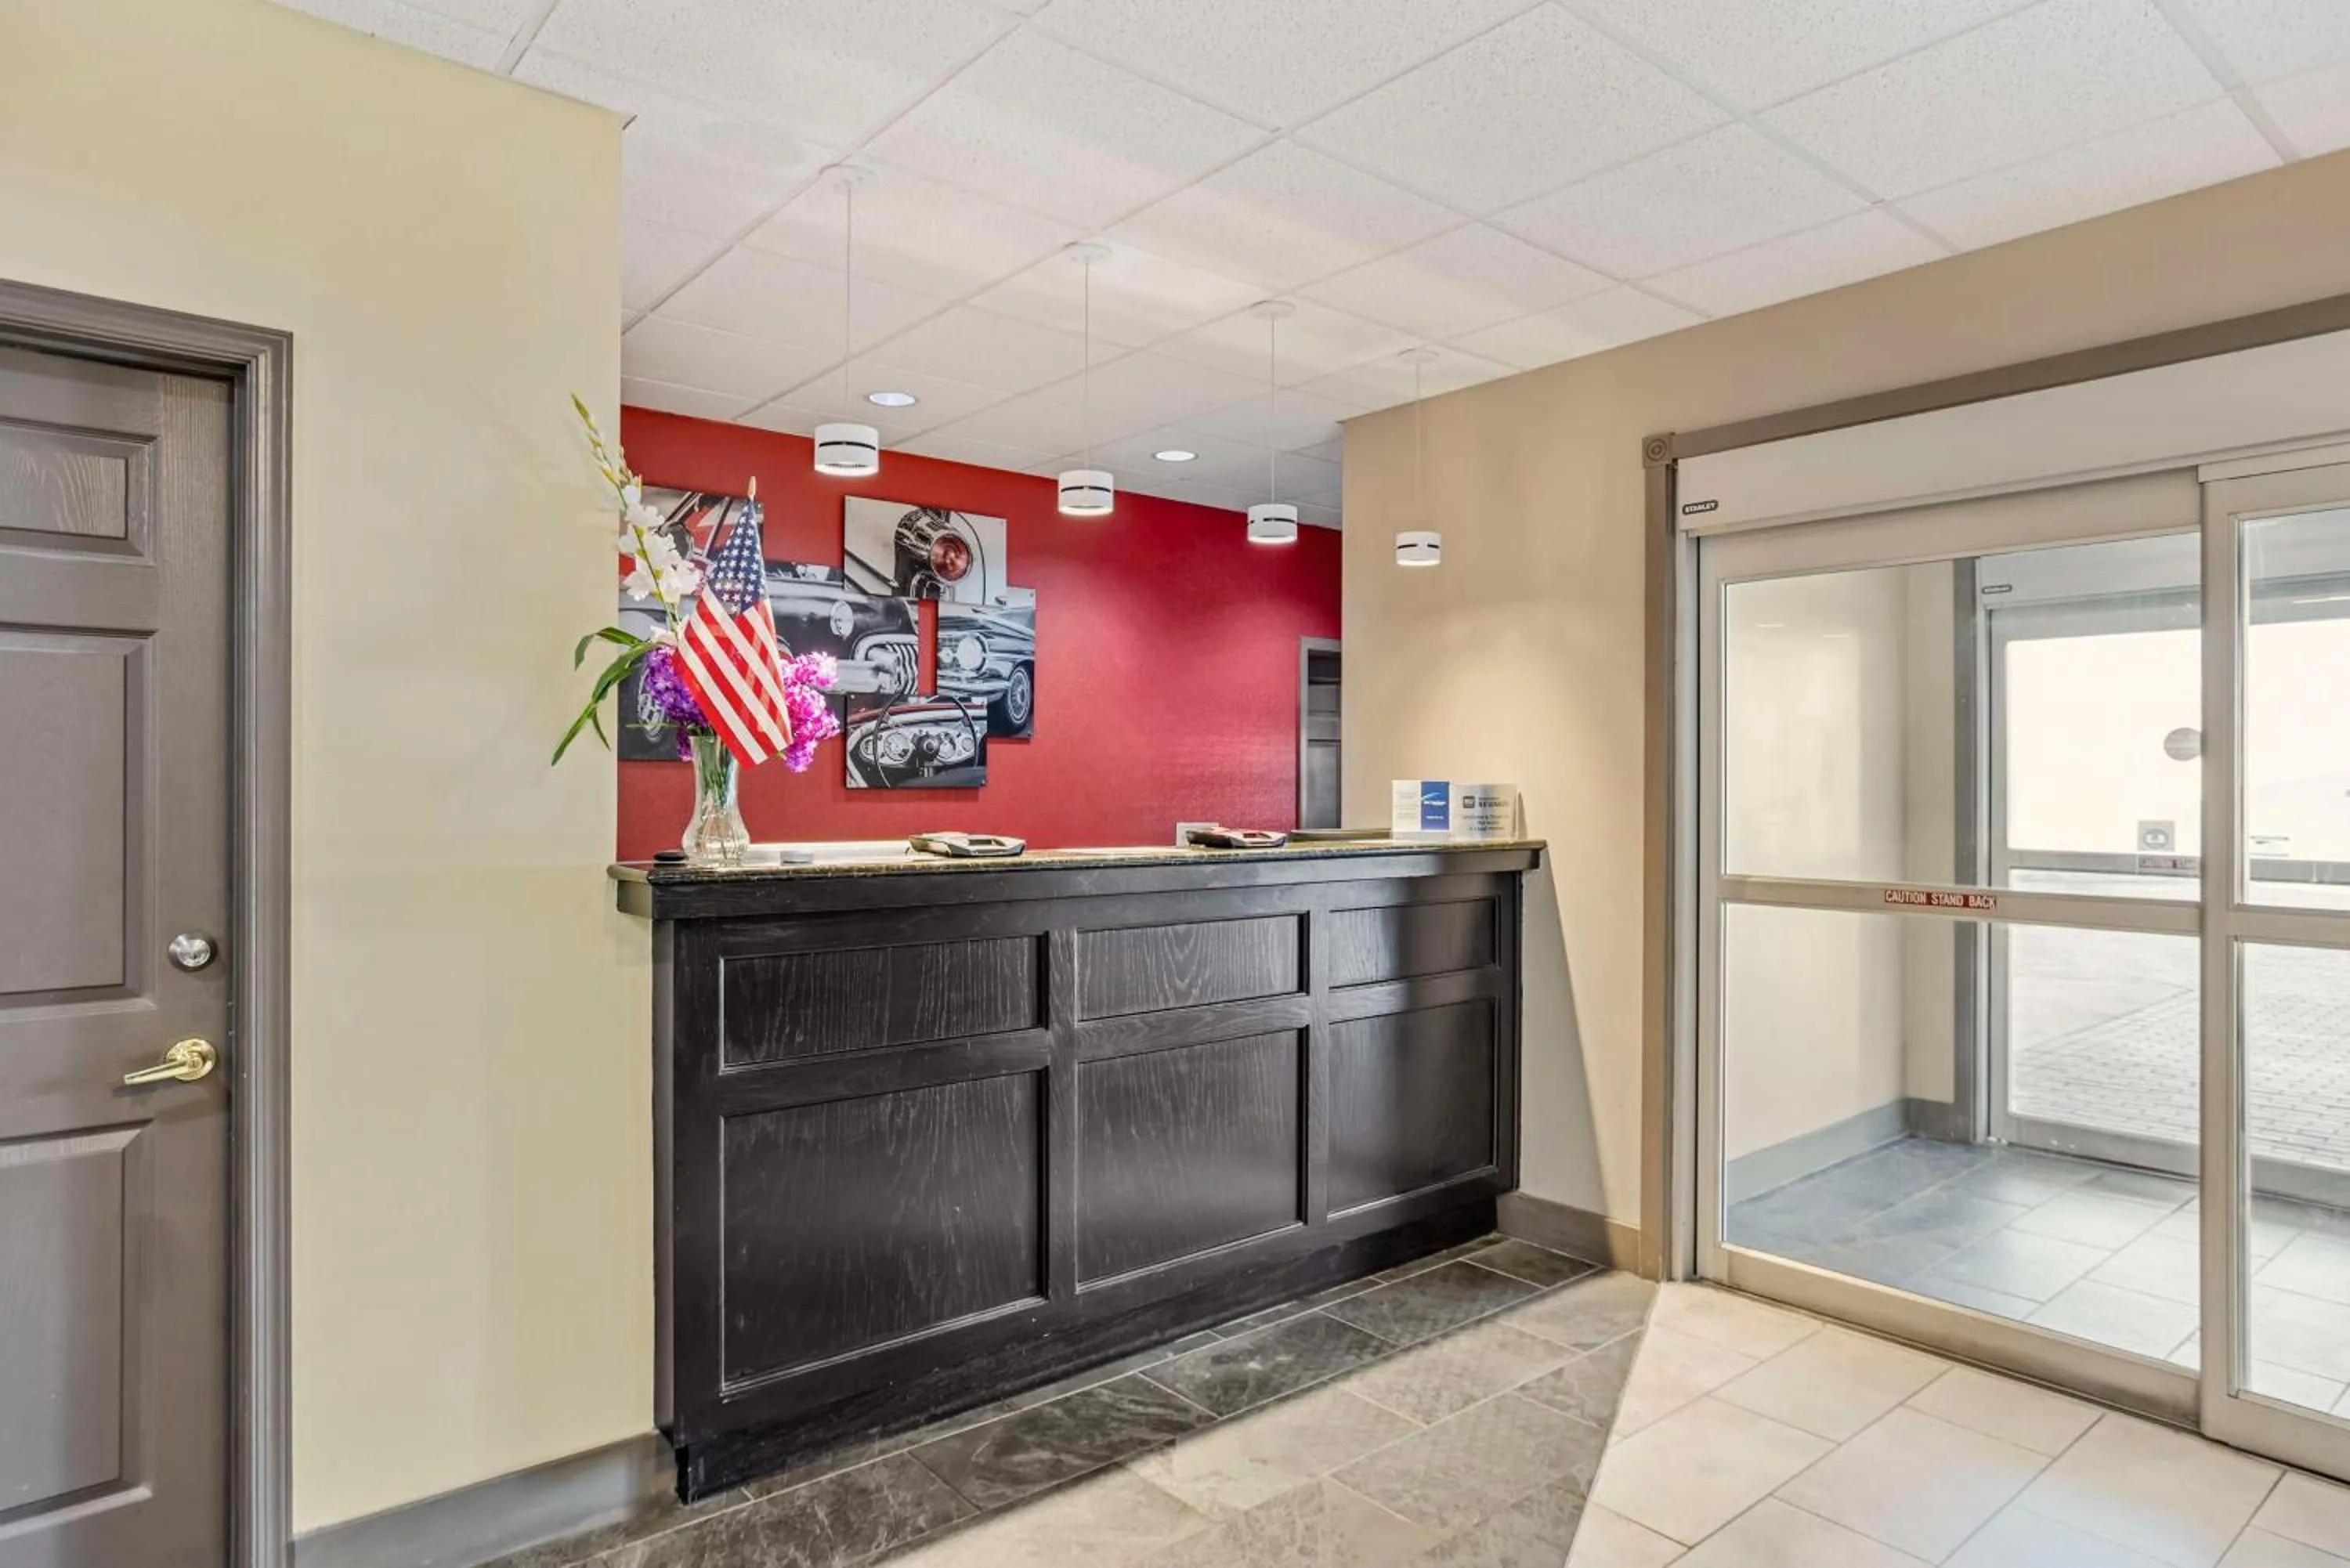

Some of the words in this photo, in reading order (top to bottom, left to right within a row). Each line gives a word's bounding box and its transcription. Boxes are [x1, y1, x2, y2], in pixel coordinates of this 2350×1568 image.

[1885, 891, 1926, 904] CAUTION
[1931, 892, 1963, 906] STAND
[1969, 895, 1995, 909] BACK
